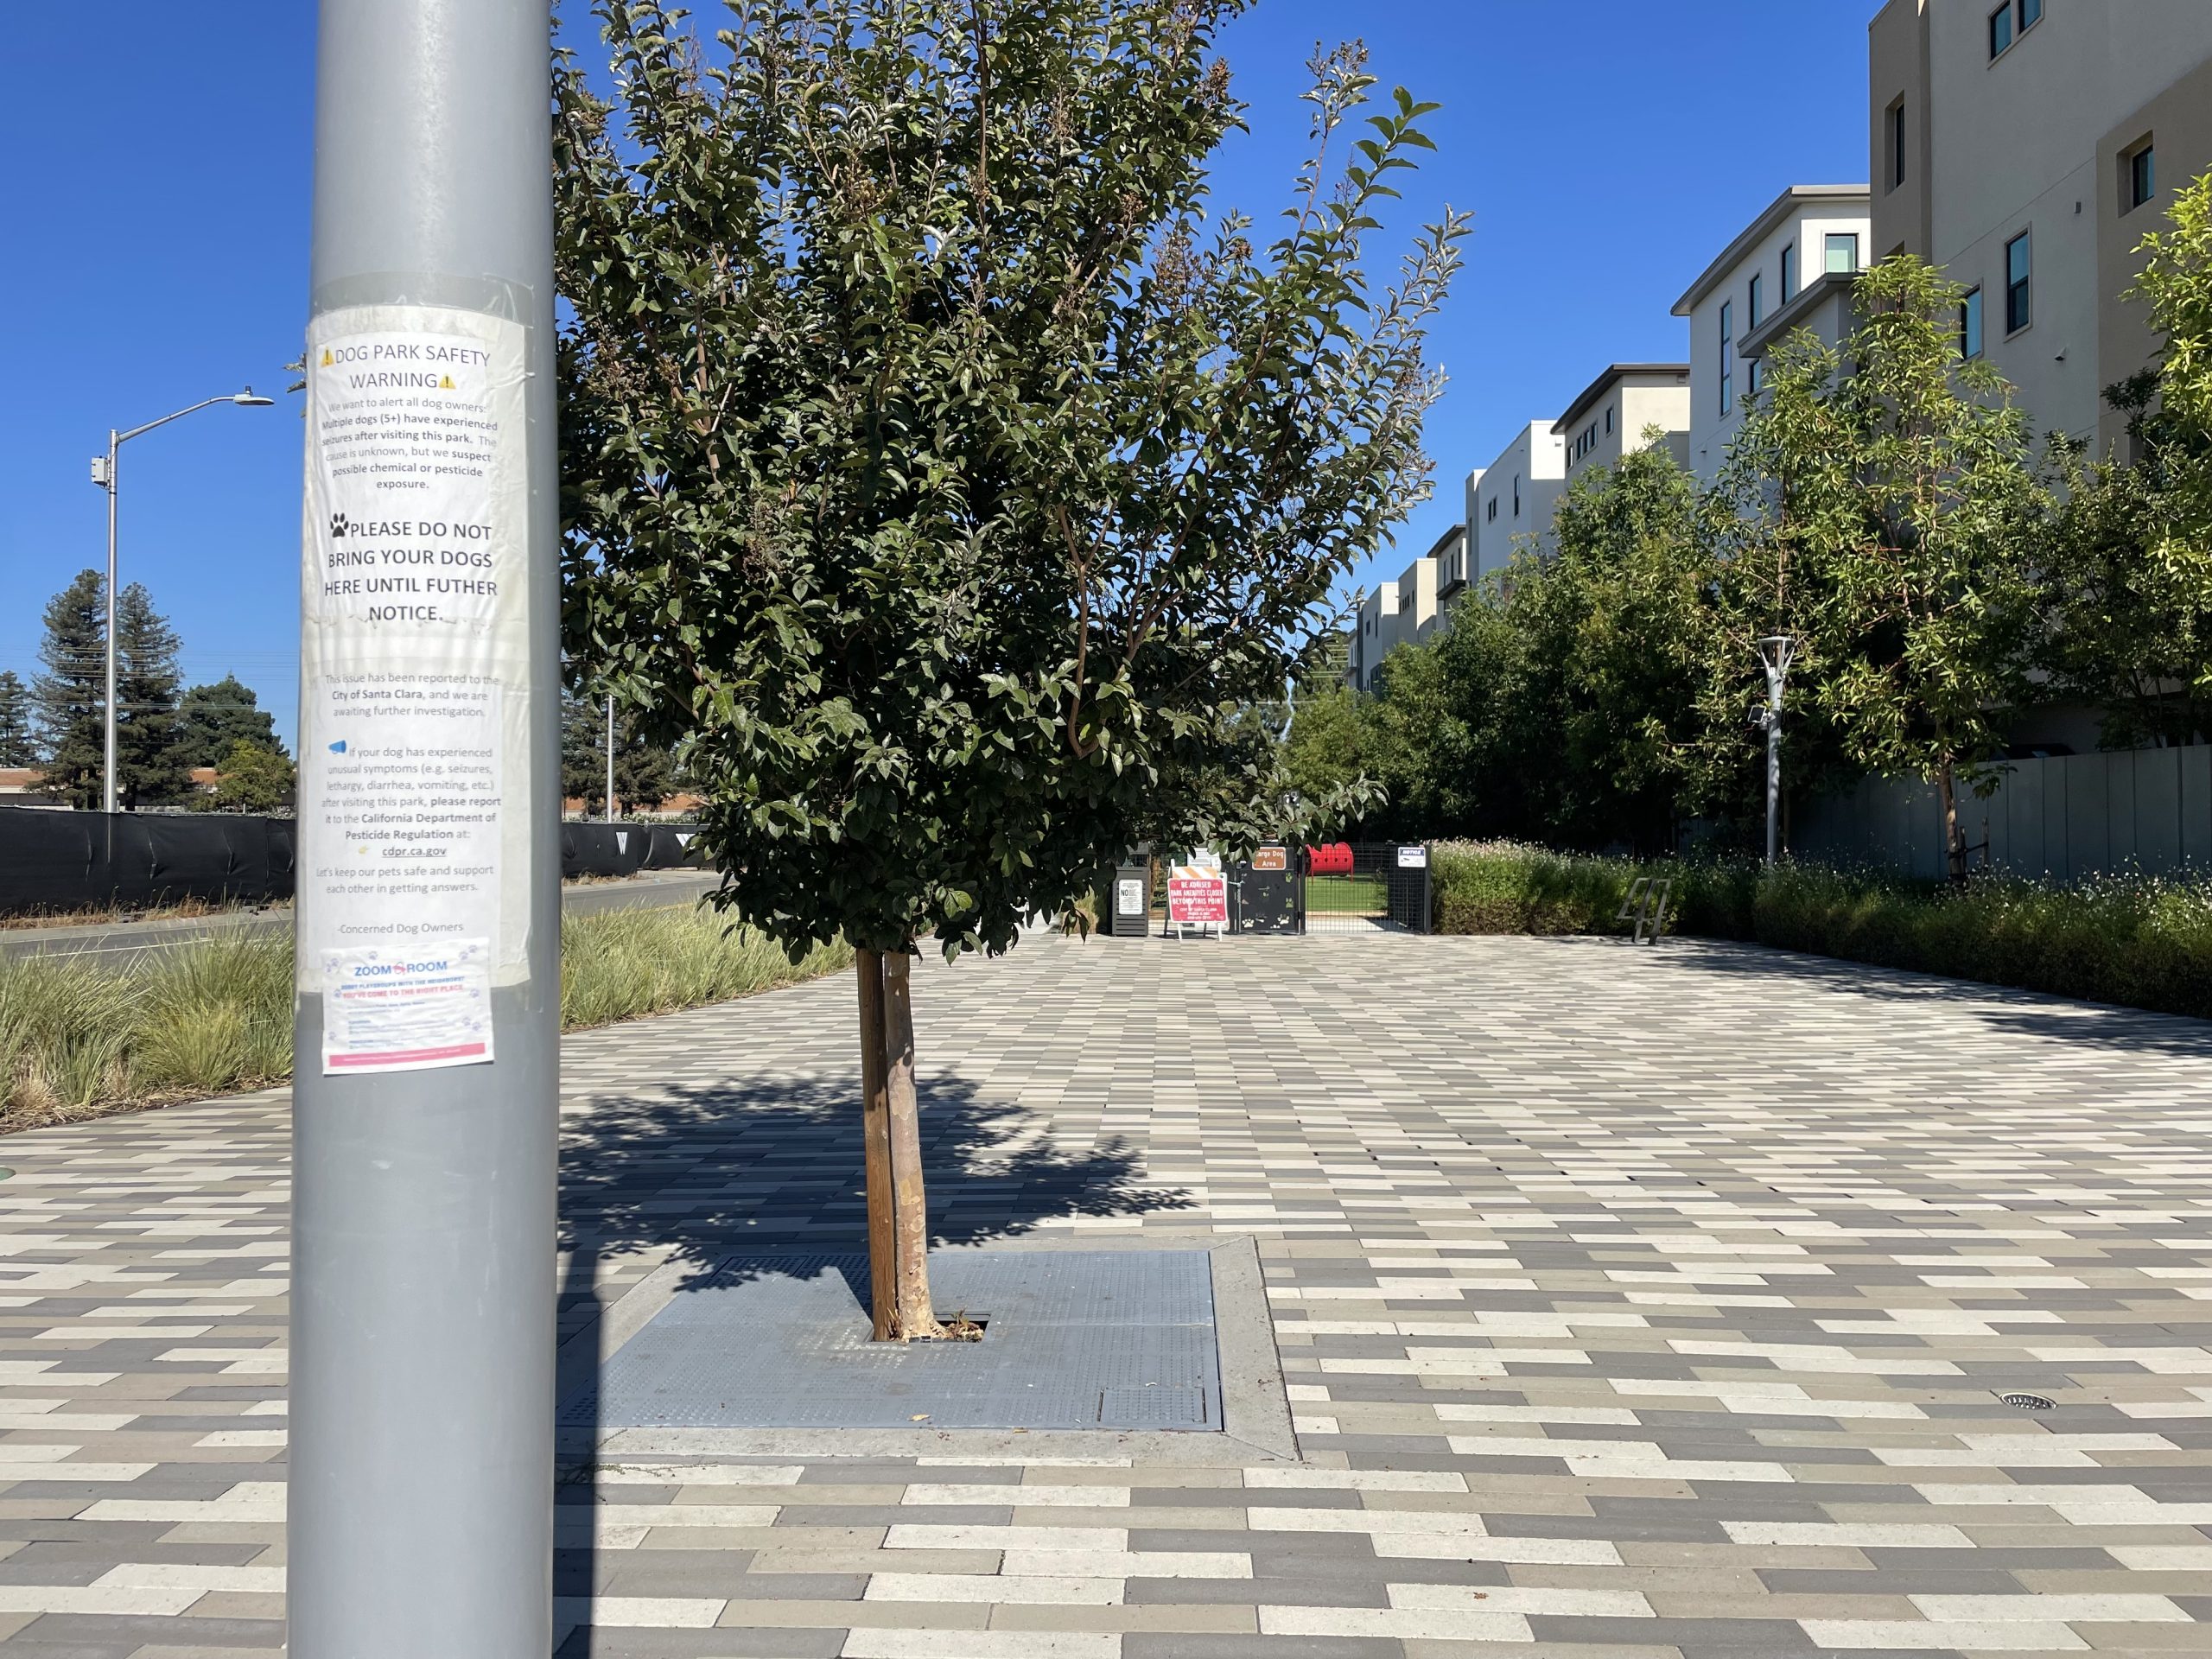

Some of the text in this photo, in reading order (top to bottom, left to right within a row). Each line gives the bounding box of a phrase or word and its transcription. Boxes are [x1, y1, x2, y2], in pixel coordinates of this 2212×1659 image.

[336, 345, 491, 366] DOG PARK SAFETY
[350, 373, 437, 389] WARNING
[328, 397, 486, 413] We want to alert all dog owners:
[322, 415, 498, 431] Multiple dogs (5+) have experienced
[321, 429, 497, 448] seizures after visiting this park. The
[326, 451, 347, 462] cause
[349, 448, 356, 458] is
[359, 447, 409, 457] unknown,
[411, 448, 429, 456] but
[452, 451, 491, 462] suspect
[333, 465, 367, 479] possible
[370, 463, 416, 473] chemical
[435, 465, 483, 477] pesticide
[376, 480, 429, 490] exposure.
[351, 522, 492, 540] PLEASE DO NOT
[329, 550, 492, 568] BRING YOUR DOGS
[325, 578, 497, 596] HERE UNTIL FUTHER
[369, 607, 442, 620] NOTICE.
[326, 675, 340, 684] This
[342, 674, 365, 683] issue
[368, 673, 385, 683] has
[388, 673, 415, 683] been
[418, 674, 466, 684] reported
[482, 676, 499, 684] the
[332, 690, 347, 702] City
[350, 690, 360, 699] of
[362, 690, 391, 699] Santa
[394, 690, 425, 700] Clara,
[429, 691, 449, 700] and
[333, 706, 485, 718] awaiting further investigation.
[349, 747, 492, 759] If your dog has experienced
[327, 764, 493, 776] unusual symptoms (e.g. seizures,
[327, 780, 494, 792] lethargy, diarrhea, vomiting, etc.)
[321, 797, 501, 808] after visiting this park, please report
[326, 814, 332, 823] it
[344, 814, 359, 823] the
[361, 813, 412, 823] California
[416, 813, 482, 824] Department
[486, 812, 496, 823] of
[346, 831, 390, 841] Pesticide
[393, 830, 454, 842] Regulation
[382, 847, 447, 858] cdpr.ca.gov
[1272, 851, 1284, 859] Dog
[316, 868, 333, 877] Let's
[335, 868, 355, 878] keep
[378, 868, 401, 878] pets
[404, 867, 427, 876] safe
[429, 867, 450, 875] and
[454, 866, 493, 876] support
[327, 882, 478, 894] each other in getting answers.
[337, 923, 463, 934] -Concerned Dog Owners
[355, 961, 447, 976] ZOOM ROOM
